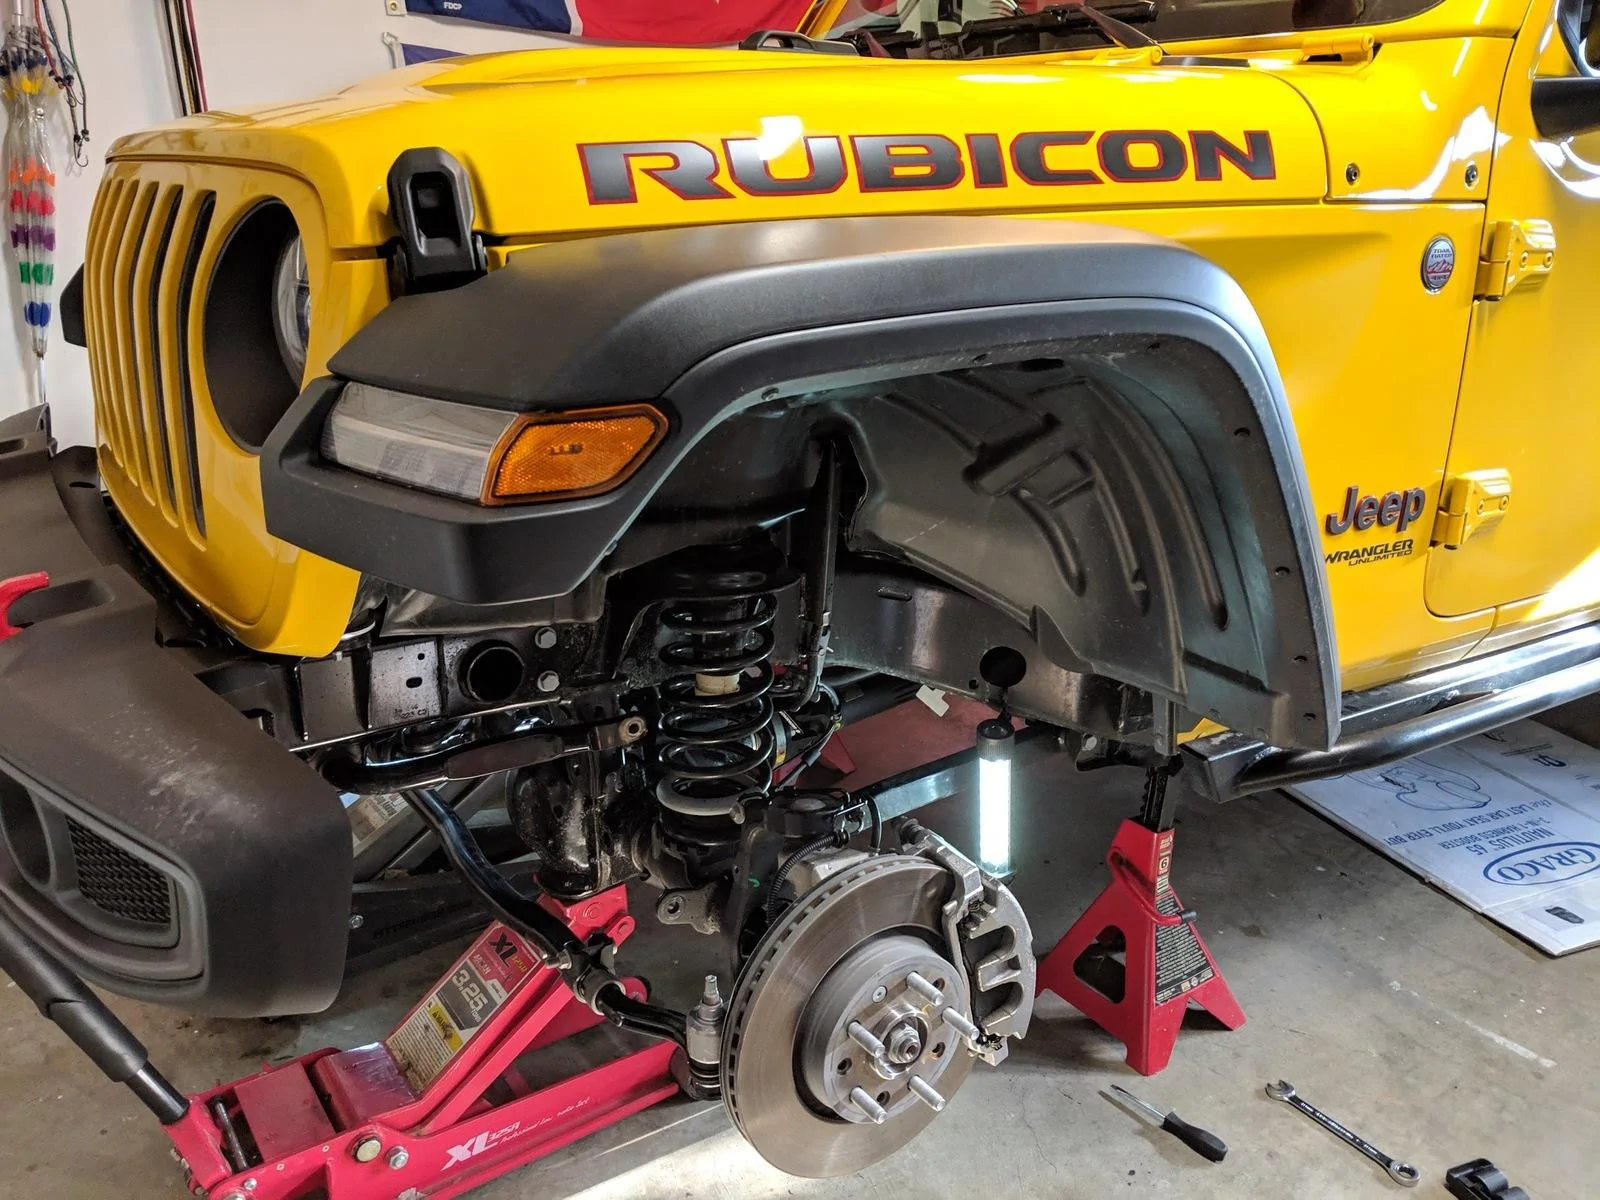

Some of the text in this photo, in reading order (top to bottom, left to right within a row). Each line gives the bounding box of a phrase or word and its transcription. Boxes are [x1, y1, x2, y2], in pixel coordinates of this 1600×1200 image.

[576, 129, 1276, 206] RUBICON
[1325, 485, 1426, 536] Jeep
[1325, 538, 1414, 564] WRANGLER
[1348, 549, 1413, 567] UNLIMITED
[1506, 803, 1532, 820] LAST
[1530, 798, 1551, 811] the
[1463, 813, 1489, 827] SEAT
[1486, 809, 1509, 823] CAR
[1381, 834, 1405, 846] BUY
[1403, 828, 1432, 840] EVER
[1481, 824, 1520, 839] HARNESS
[1437, 834, 1482, 849] BOOSTER
[1465, 843, 1489, 856] 65
[1496, 848, 1597, 882] GRACO
[488, 931, 515, 969] XL
[453, 968, 488, 1011] 3.25
[440, 1129, 498, 1172] XL
